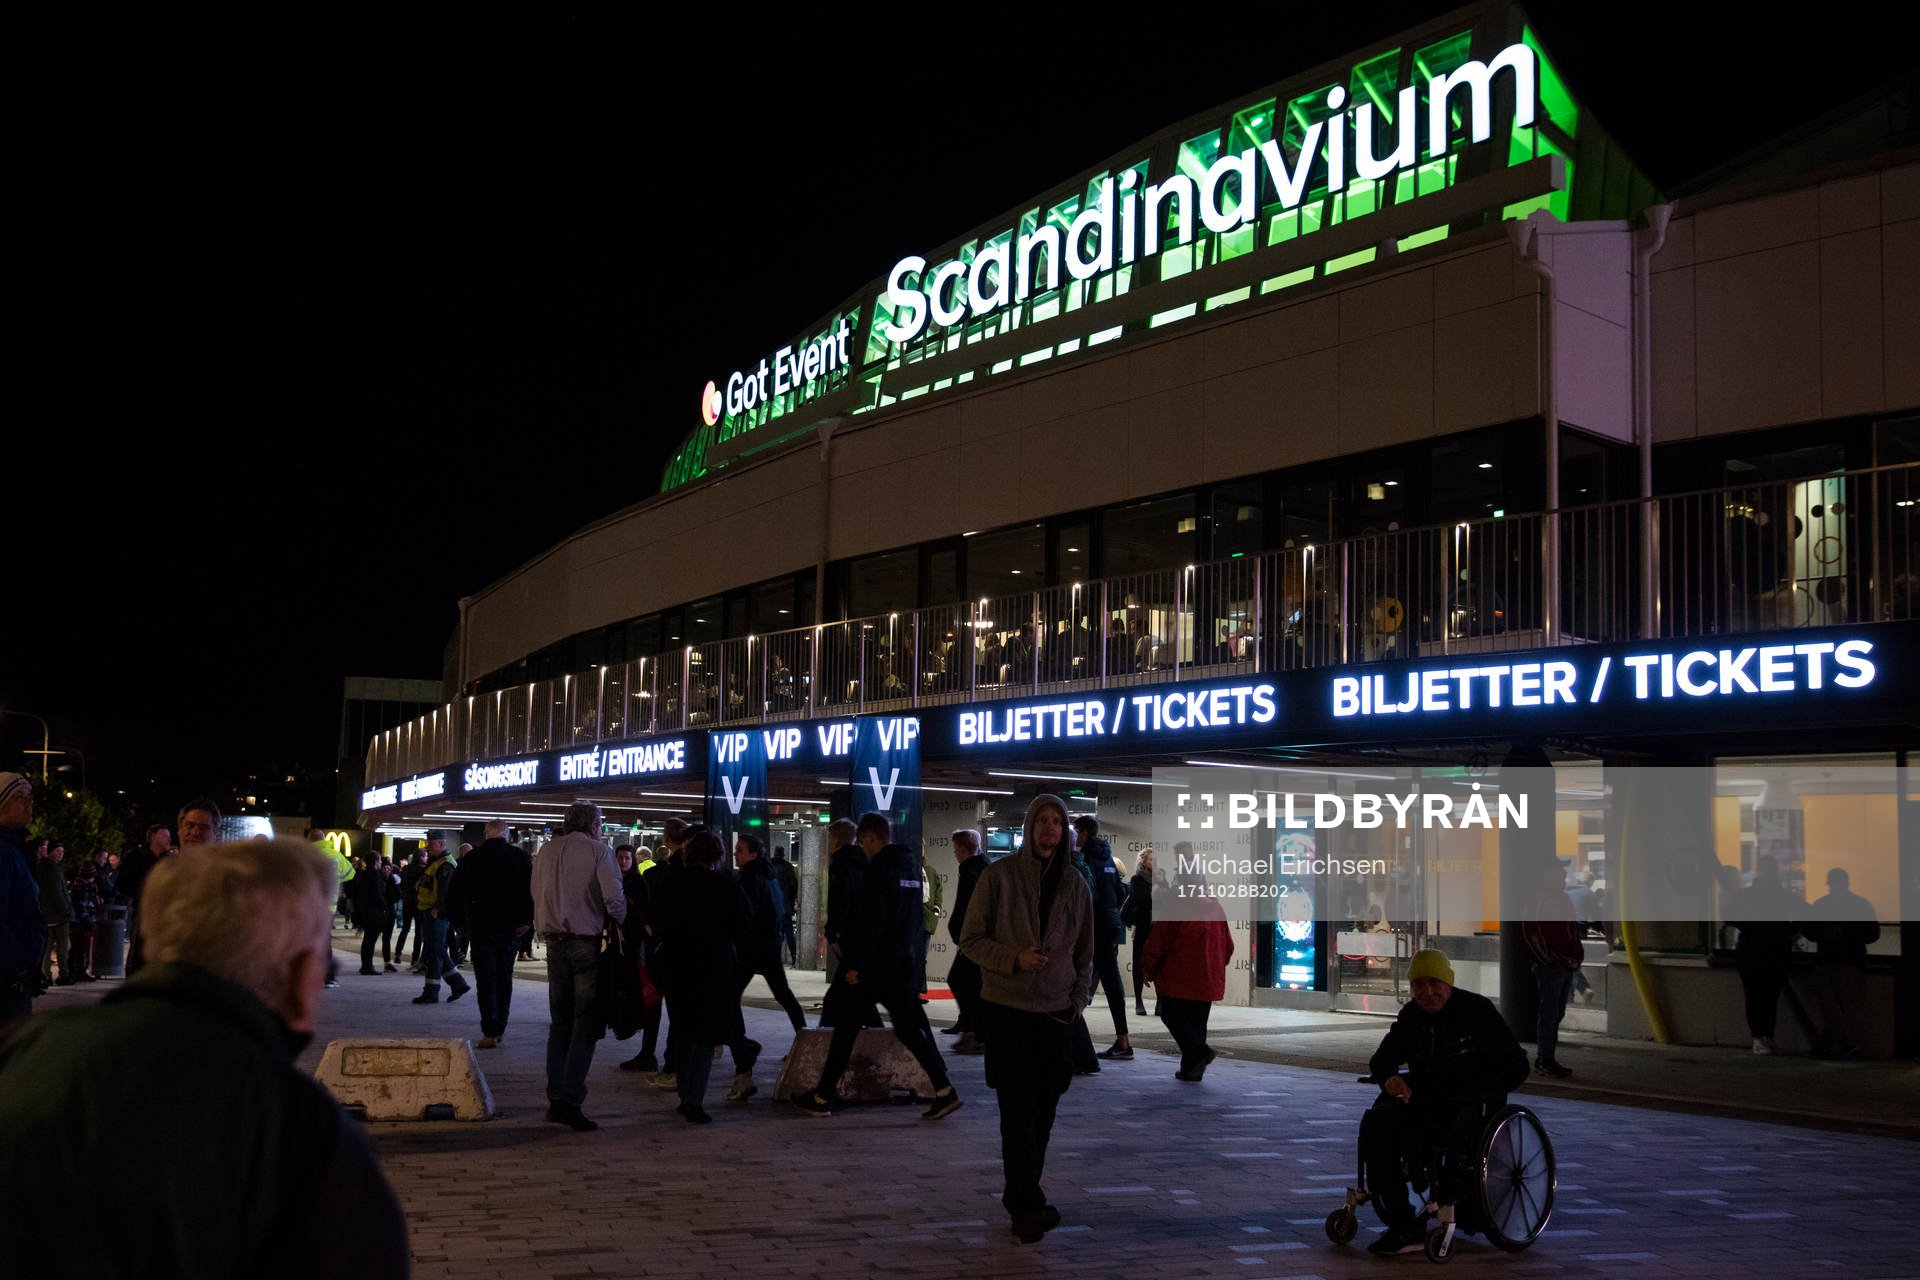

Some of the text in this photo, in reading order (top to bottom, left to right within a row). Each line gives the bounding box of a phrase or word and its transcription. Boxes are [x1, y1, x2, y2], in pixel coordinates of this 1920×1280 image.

[886, 43, 1534, 343] Scandinavium
[726, 318, 849, 417] Got Event
[1333, 660, 1577, 717] BILJETTER
[1624, 640, 1876, 700] TICKETS
[877, 717, 919, 751] VIP
[959, 700, 1105, 745] BILJETTER
[1133, 684, 1276, 731] TICKETS
[714, 733, 748, 763] VIP
[764, 728, 801, 760] VIP
[818, 723, 857, 756] VIP
[560, 745, 600, 780] ENTRÉ
[608, 741, 684, 775] ENTRANCE
